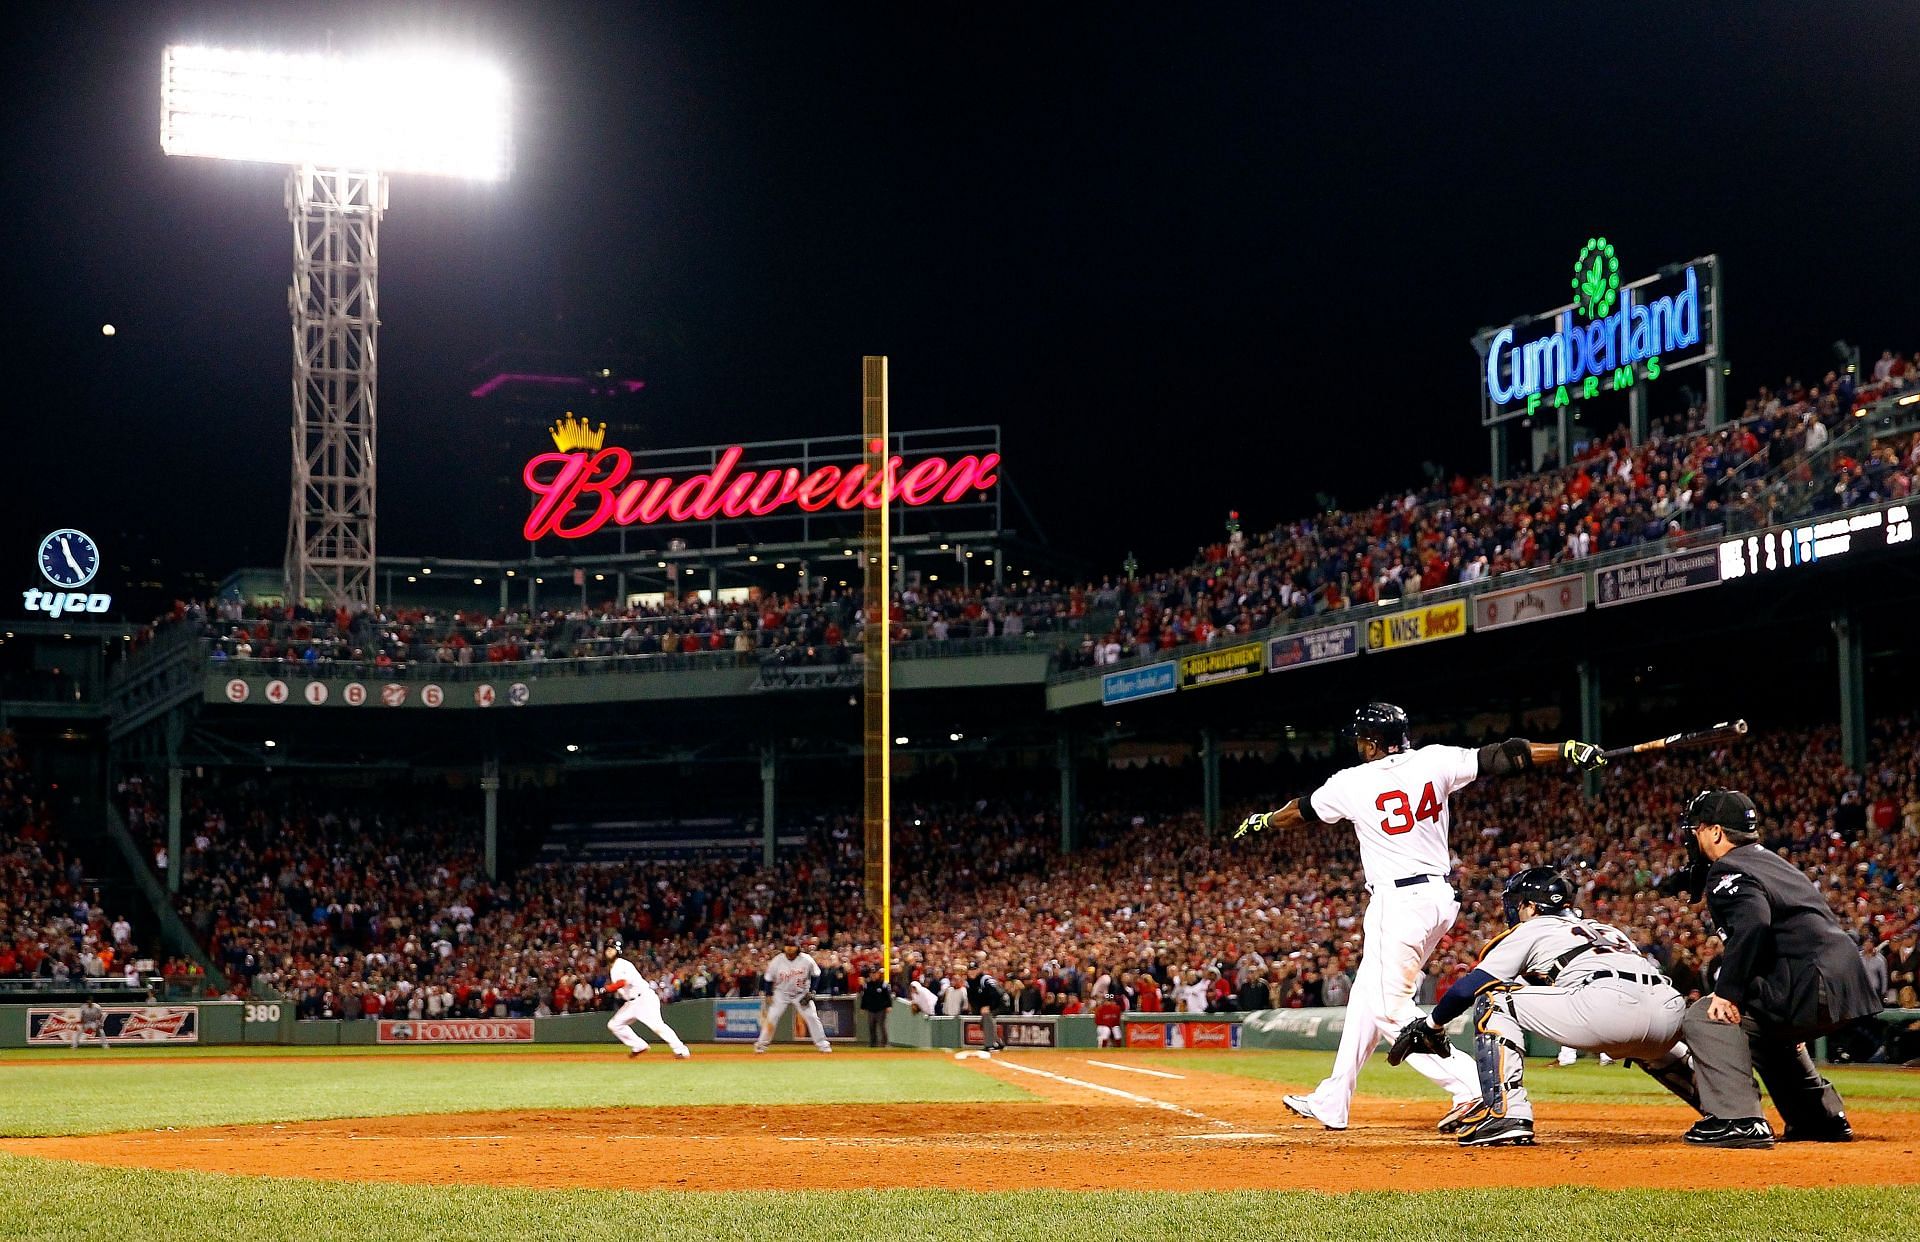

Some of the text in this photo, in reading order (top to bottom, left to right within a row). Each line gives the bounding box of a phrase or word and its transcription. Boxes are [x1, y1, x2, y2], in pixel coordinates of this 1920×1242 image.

[1488, 266, 1698, 405] Cumberland
[1527, 356, 1661, 416] FARMS
[523, 439, 1000, 541] Budweiser
[1617, 567, 1640, 584] Beth
[1618, 575, 1687, 599] Medical Center
[23, 588, 111, 618] tyco
[1375, 781, 1443, 836] 34
[245, 1004, 281, 1023] 380
[416, 1023, 518, 1039] FOXWOODS
